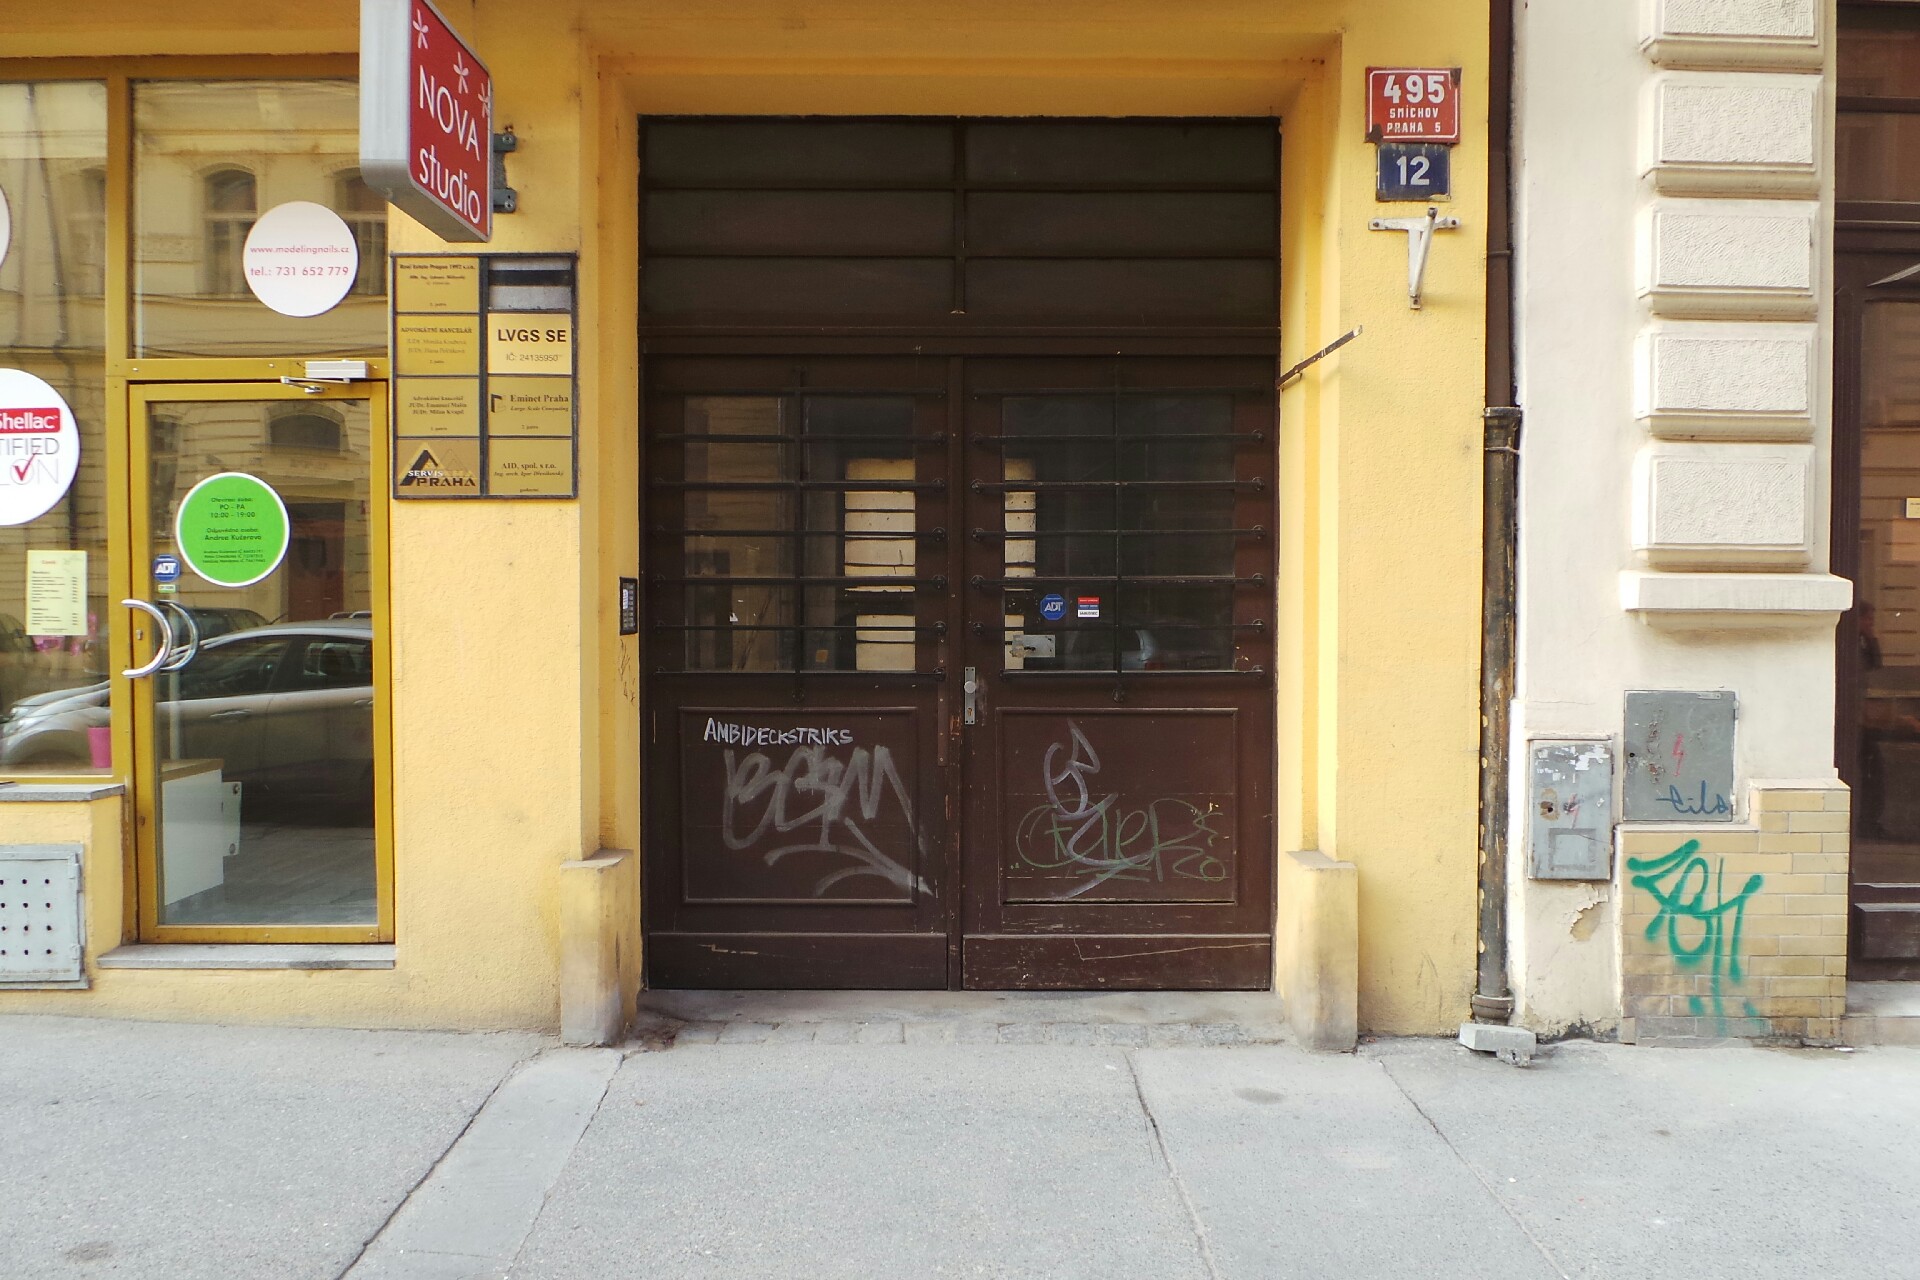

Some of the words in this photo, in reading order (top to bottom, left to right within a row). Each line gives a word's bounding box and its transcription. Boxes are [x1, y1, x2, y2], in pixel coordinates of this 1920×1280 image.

[1383, 75, 1445, 103] 495
[420, 65, 480, 161] NOVA
[1387, 122, 1423, 133] PRAHA
[1435, 122, 1441, 132] 5
[1396, 155, 1430, 186] 12
[419, 145, 480, 224] studio
[250, 245, 349, 254] www.modelingnails.cz
[250, 267, 271, 276] tel.:
[276, 267, 296, 276] 731
[302, 267, 323, 276] 652
[328, 267, 349, 276] 779
[498, 329, 540, 342] LVGS
[546, 329, 567, 342] SE
[417, 478, 476, 486] PRAHA
[155, 562, 176, 574] ADT
[1044, 602, 1063, 612] ADT
